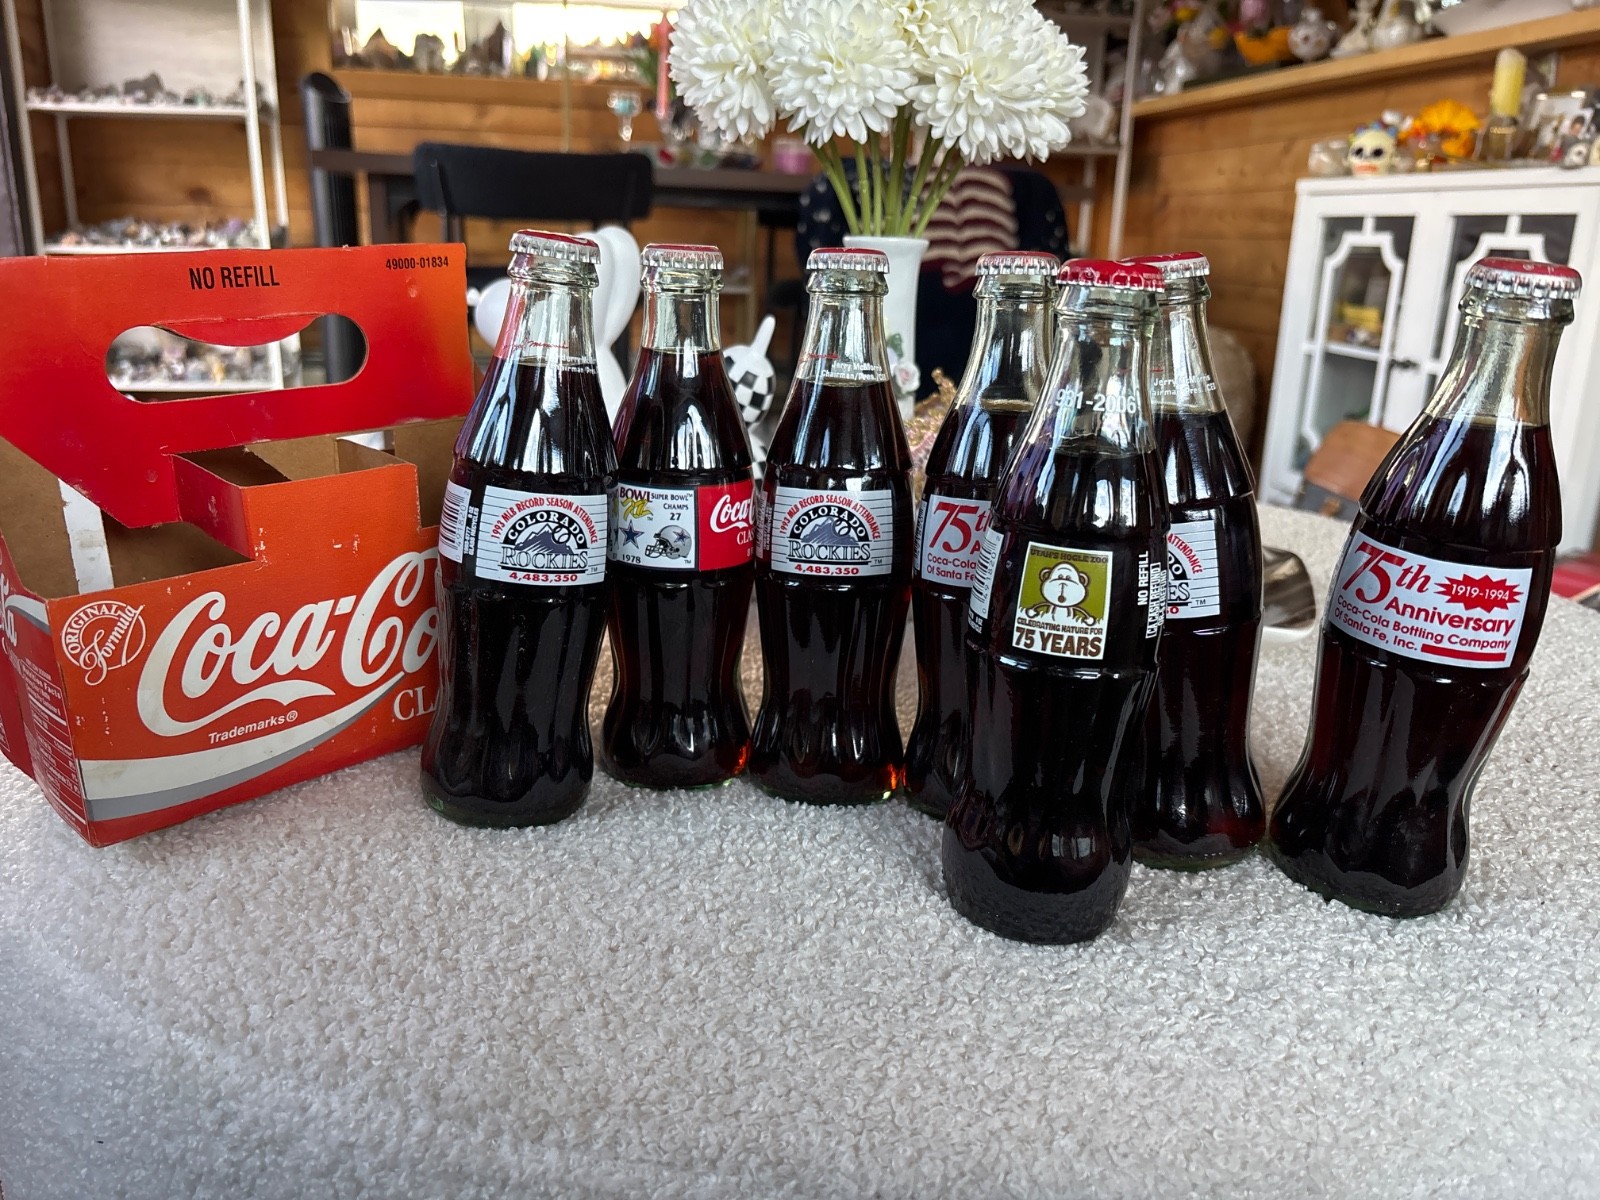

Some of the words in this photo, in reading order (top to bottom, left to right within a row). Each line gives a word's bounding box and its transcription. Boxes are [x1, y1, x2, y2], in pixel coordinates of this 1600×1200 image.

[385, 256, 449, 270] 49000-01834
[189, 267, 215, 290] NO
[220, 265, 280, 288] REFILL
[1055, 388, 1137, 414] 981-2006
[620, 487, 653, 503] BOWL
[651, 493, 669, 501] SUPER
[663, 503, 689, 511] CHAMPS
[491, 521, 505, 540] 1993
[501, 507, 517, 523] MLB
[516, 497, 545, 513] RECORD
[546, 497, 574, 511] SEASON
[573, 505, 599, 544] ATTENDANCE
[507, 511, 586, 545] COLORADO
[670, 512, 682, 521] 27
[779, 518, 791, 535] 1993
[787, 504, 800, 519] MLB
[798, 495, 824, 510] RECORD
[826, 494, 853, 508] SEASON
[852, 503, 881, 540] ATTENDANCE
[793, 506, 866, 537] COLORADO
[499, 545, 589, 570] ROCKIES
[622, 554, 641, 564] 1978
[786, 539, 871, 561] ROCKIES
[927, 552, 977, 570] Coca-Cola
[1090, 556, 1109, 564] ZOO
[1167, 533, 1203, 574] ATTENDANCE
[509, 572, 578, 583] 4,483,350
[794, 564, 860, 575] 4,483,350
[935, 567, 962, 581] Santa
[1138, 551, 1149, 588] REFILL
[1342, 541, 1430, 604] 75th
[1150, 567, 1161, 600] REFUND
[1451, 583, 1509, 601] 1919-1994
[1137, 590, 1149, 606] NO
[1017, 617, 1061, 632] CELEBRATING
[1061, 624, 1089, 635] NATURE
[1089, 627, 1103, 636] FOR
[1337, 595, 1390, 628] Coca-Cola
[1392, 620, 1444, 644] Bottling
[1447, 633, 1511, 651] Company
[1384, 596, 1516, 637] Anniversary
[66, 604, 122, 655] ORIGINAL
[137, 547, 440, 737] Coca-Co
[1015, 626, 1036, 649] 75
[1038, 631, 1104, 657] YEARS
[1334, 608, 1345, 619] Of
[1343, 613, 1371, 635] Santa
[1373, 629, 1389, 644] Fe,
[1393, 635, 1418, 651] Inc.
[80, 605, 145, 686] Formula
